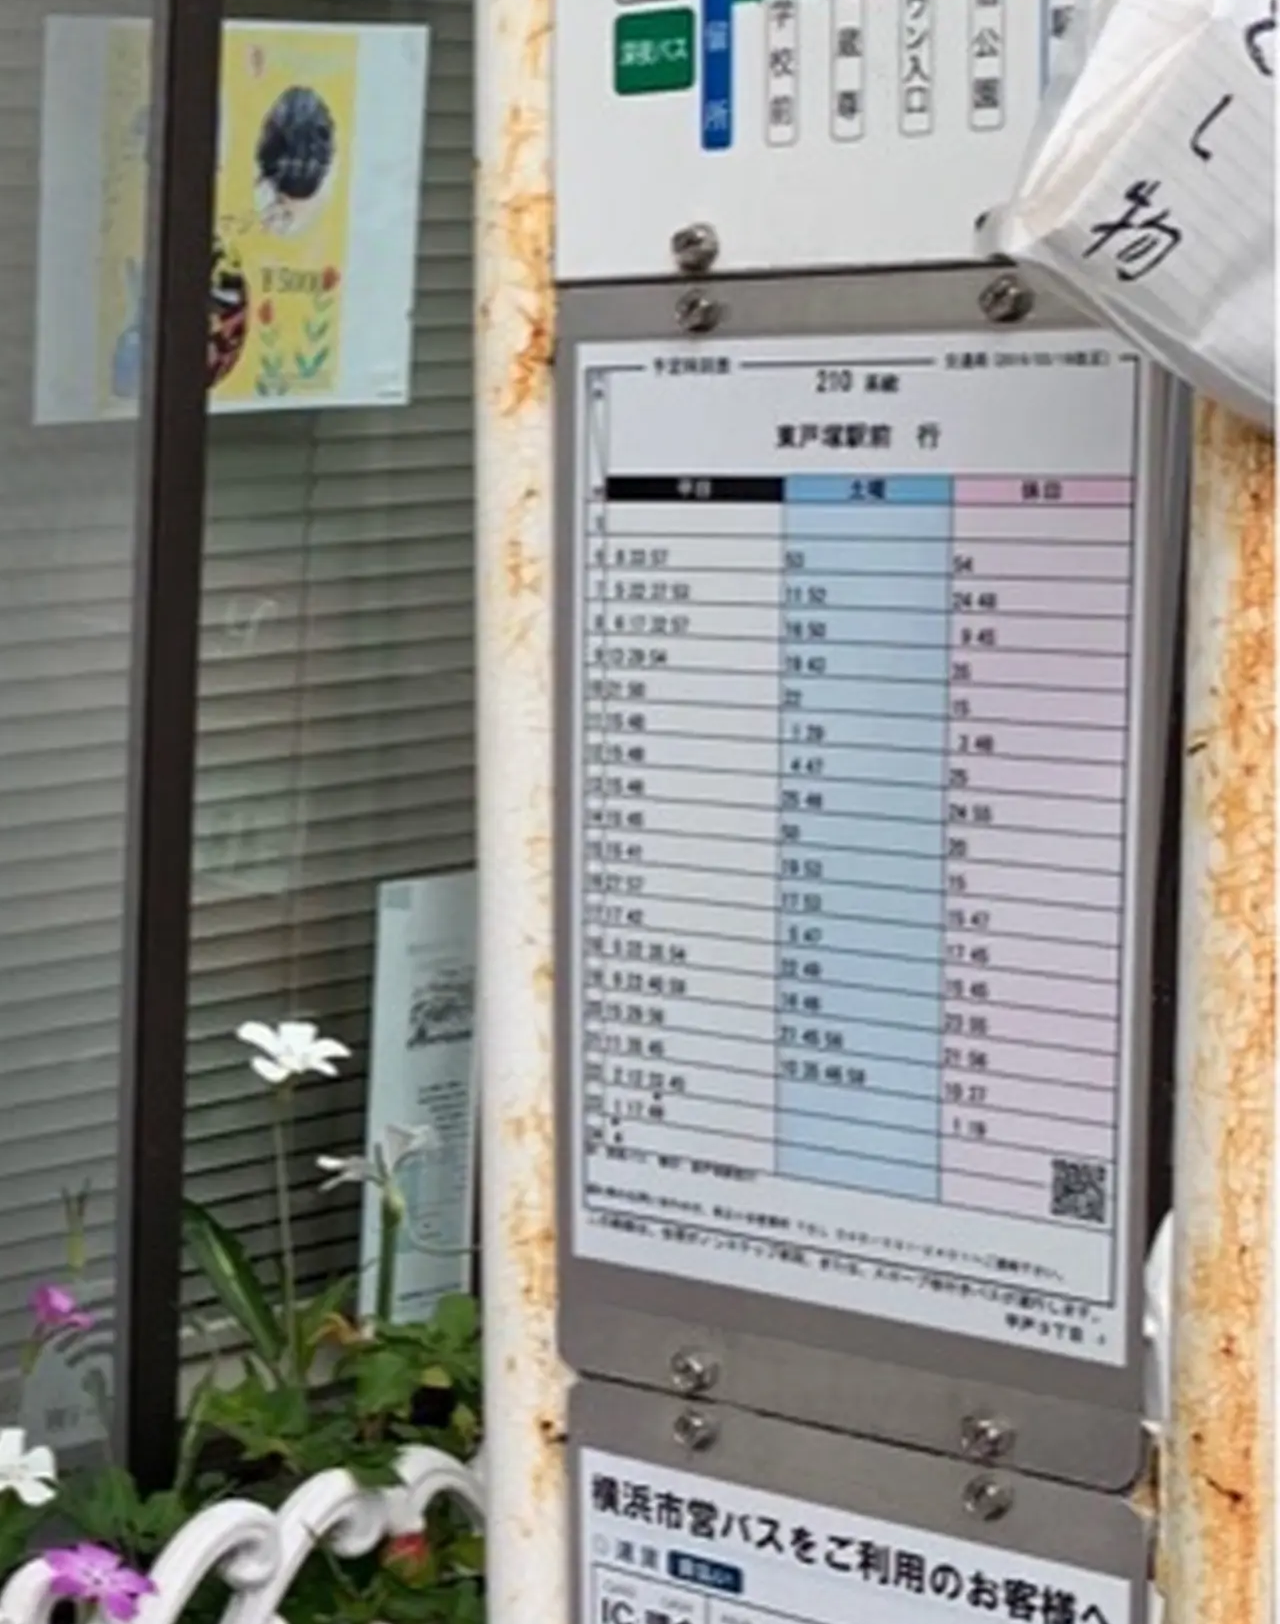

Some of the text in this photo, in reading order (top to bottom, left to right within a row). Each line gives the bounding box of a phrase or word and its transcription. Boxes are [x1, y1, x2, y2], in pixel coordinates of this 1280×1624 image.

[815, 369, 853, 393] 210
[775, 423, 941, 450] 東戸塚駅前 行
[849, 479, 886, 501] 土曜
